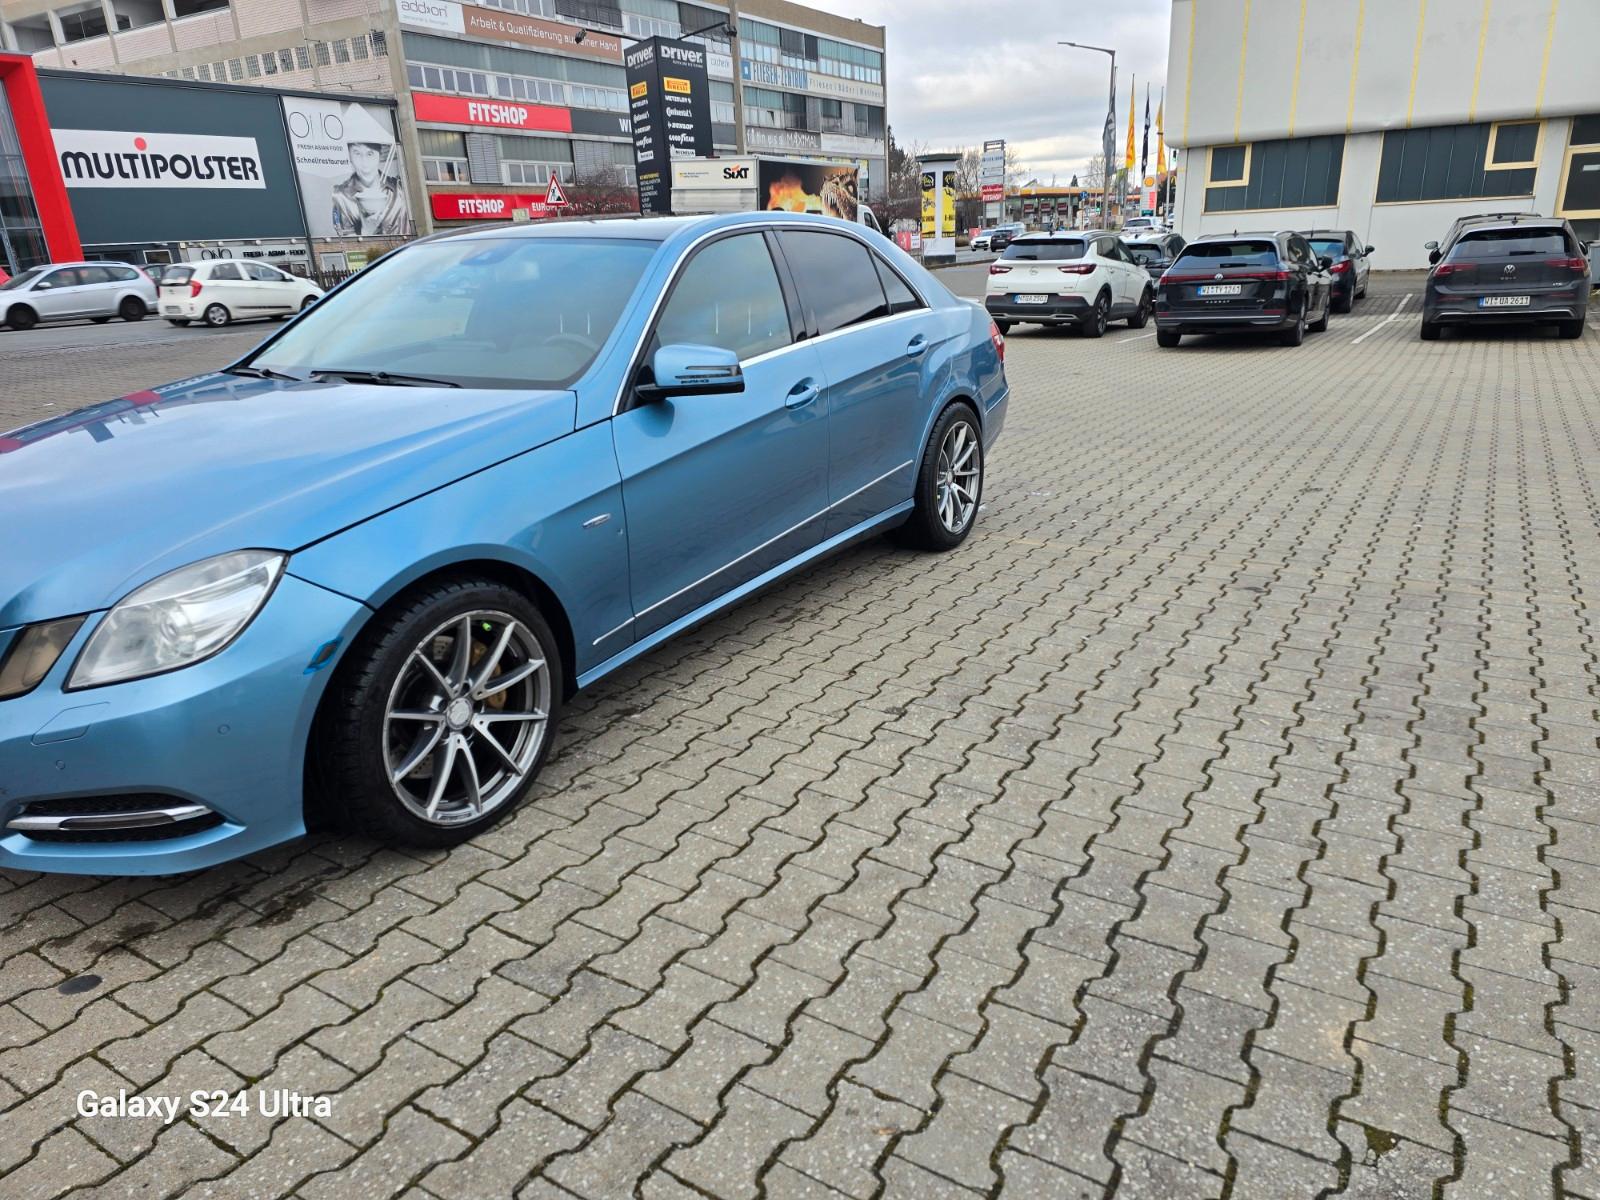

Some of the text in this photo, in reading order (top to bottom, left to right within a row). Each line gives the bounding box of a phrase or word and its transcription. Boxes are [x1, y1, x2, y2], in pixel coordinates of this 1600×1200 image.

[470, 16, 497, 30] Arbeit
[499, 22, 505, 32] &
[506, 22, 563, 44] Qualifizierung
[600, 40, 618, 51] Hand
[468, 102, 528, 125] FITSHOP
[61, 137, 259, 180] MULTIPOLSTER
[296, 157, 349, 165] Schnellrestaurant
[458, 199, 504, 213] FITSHOP
